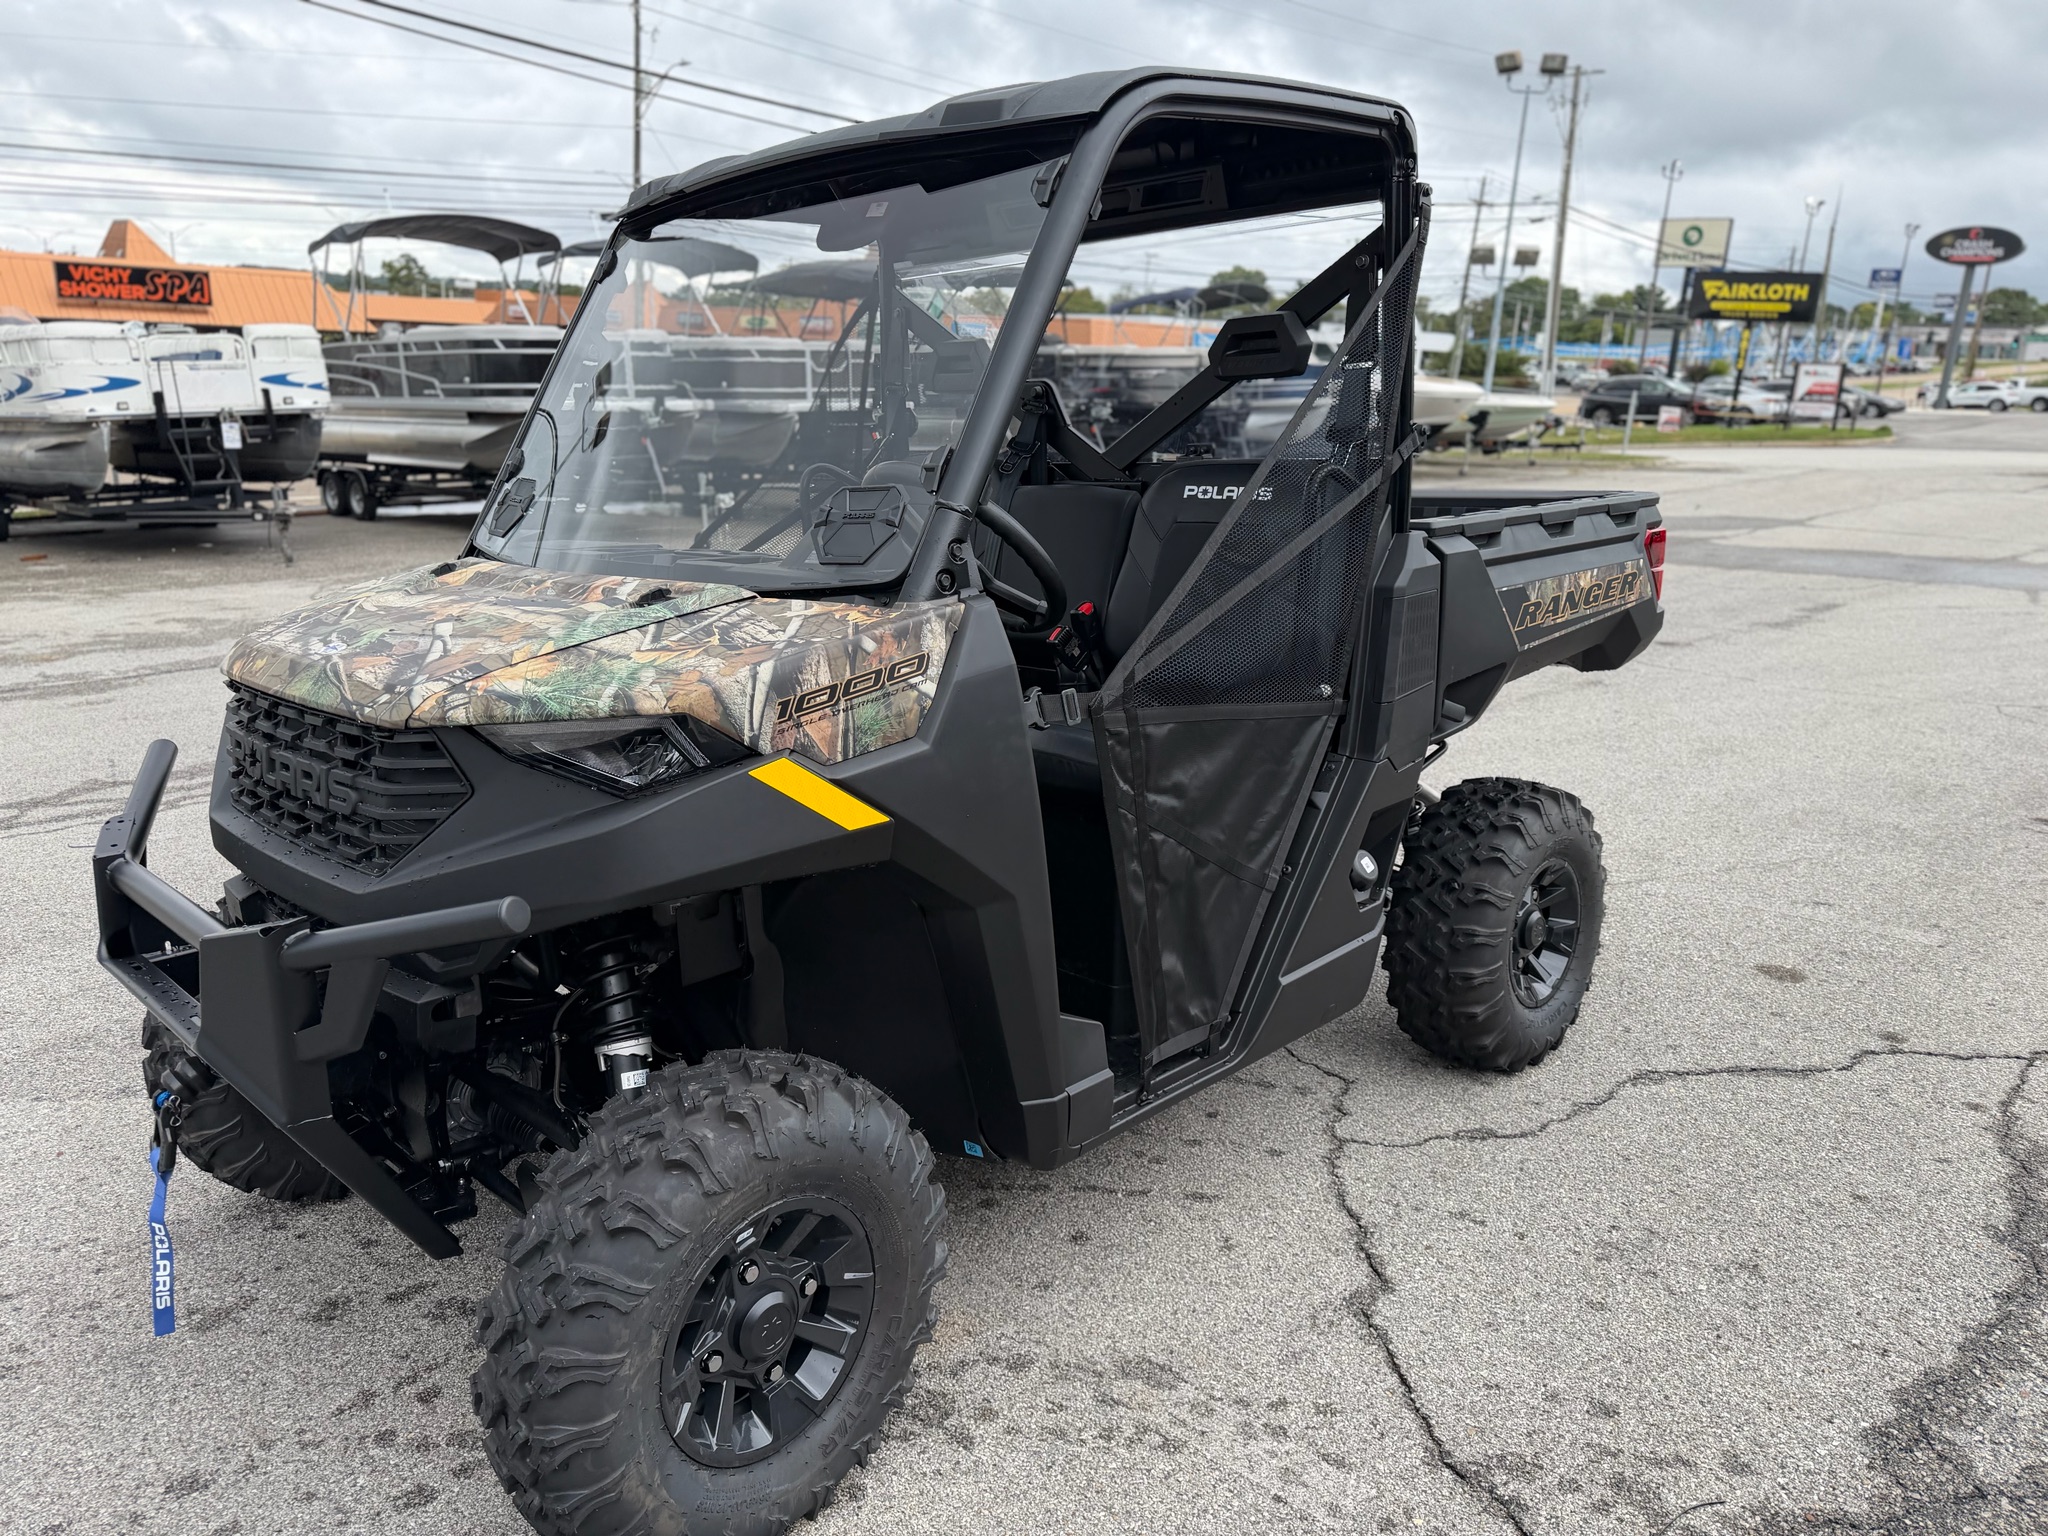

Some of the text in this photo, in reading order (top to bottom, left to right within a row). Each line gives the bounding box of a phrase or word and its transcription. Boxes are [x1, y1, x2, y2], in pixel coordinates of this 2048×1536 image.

[59, 270, 209, 303] SHOWER SPA
[68, 264, 131, 282] VICHY
[1702, 279, 1809, 301] FAIRCLOTH
[1514, 570, 1639, 631] RANGER
[775, 651, 930, 724] 1000
[777, 680, 928, 735] SINGLE OVERHEAD CAM
[151, 1222, 171, 1310] POLARIS
